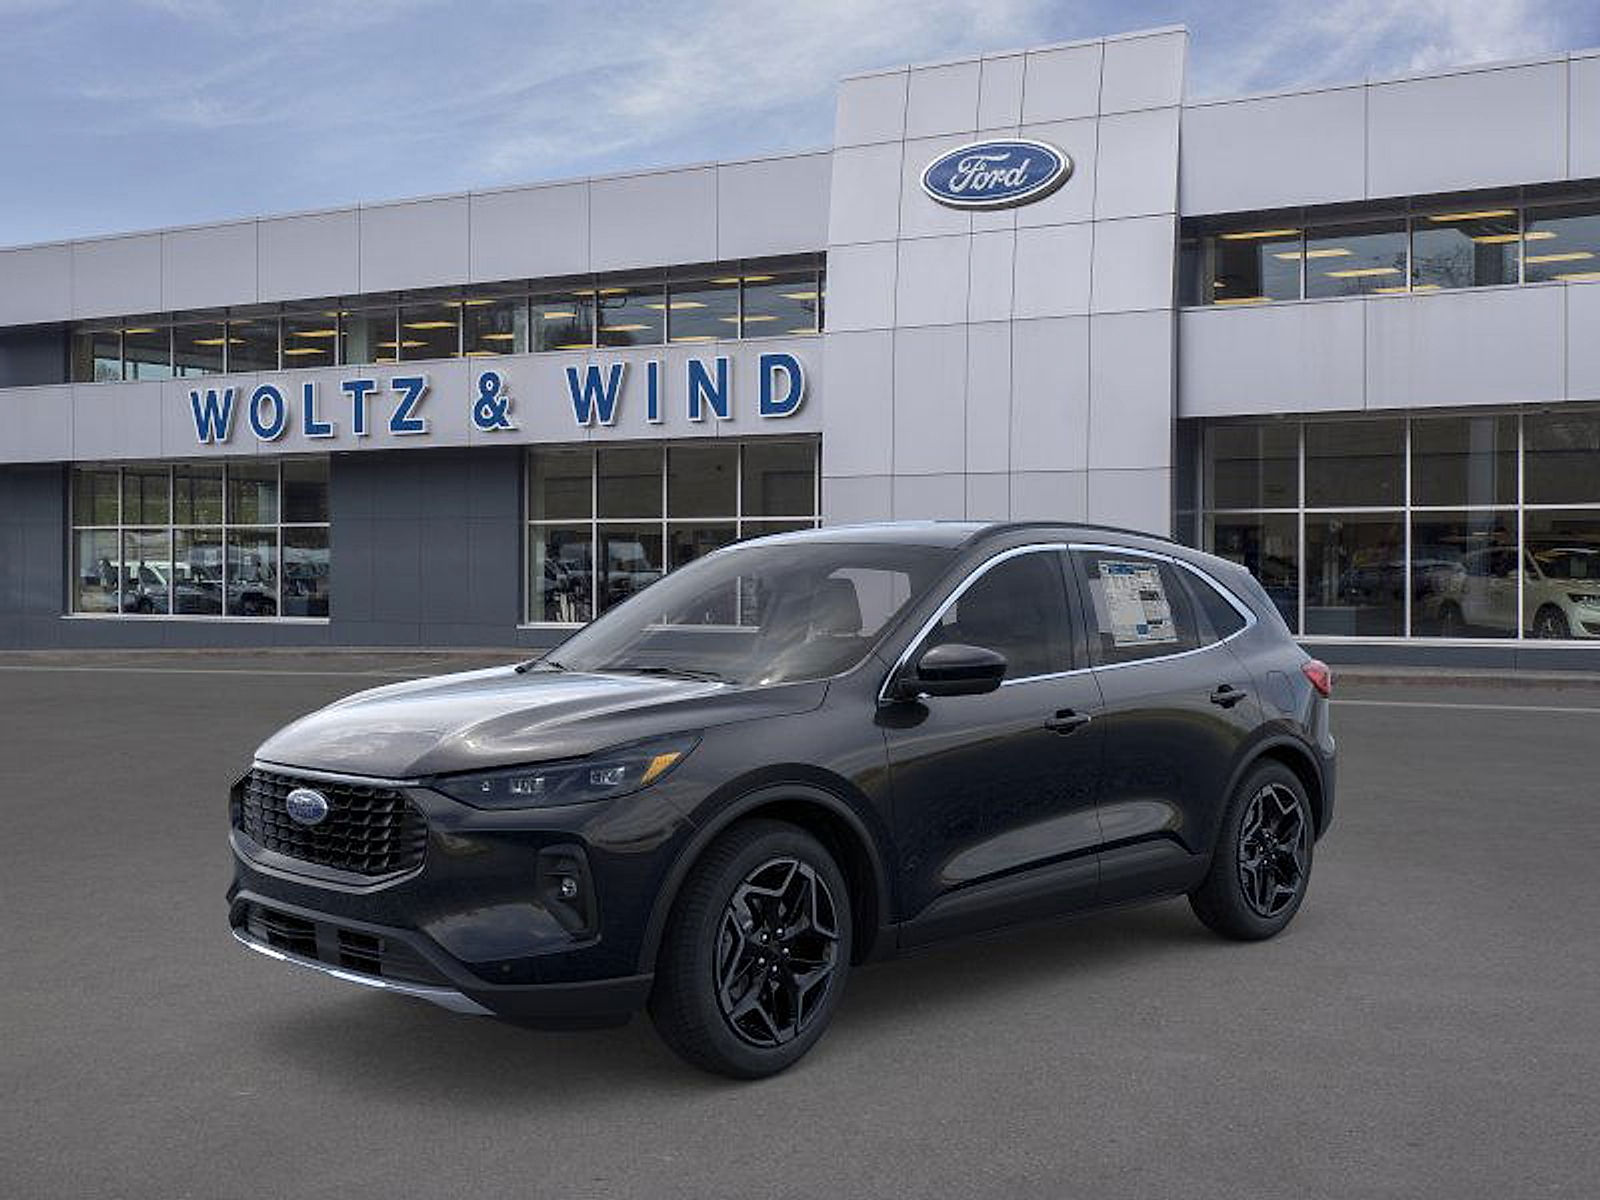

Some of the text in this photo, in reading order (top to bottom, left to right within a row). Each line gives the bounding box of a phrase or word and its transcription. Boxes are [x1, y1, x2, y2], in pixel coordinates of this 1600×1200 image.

[949, 152, 1031, 193] Ford
[189, 352, 806, 443] WOLTZ & WIND
